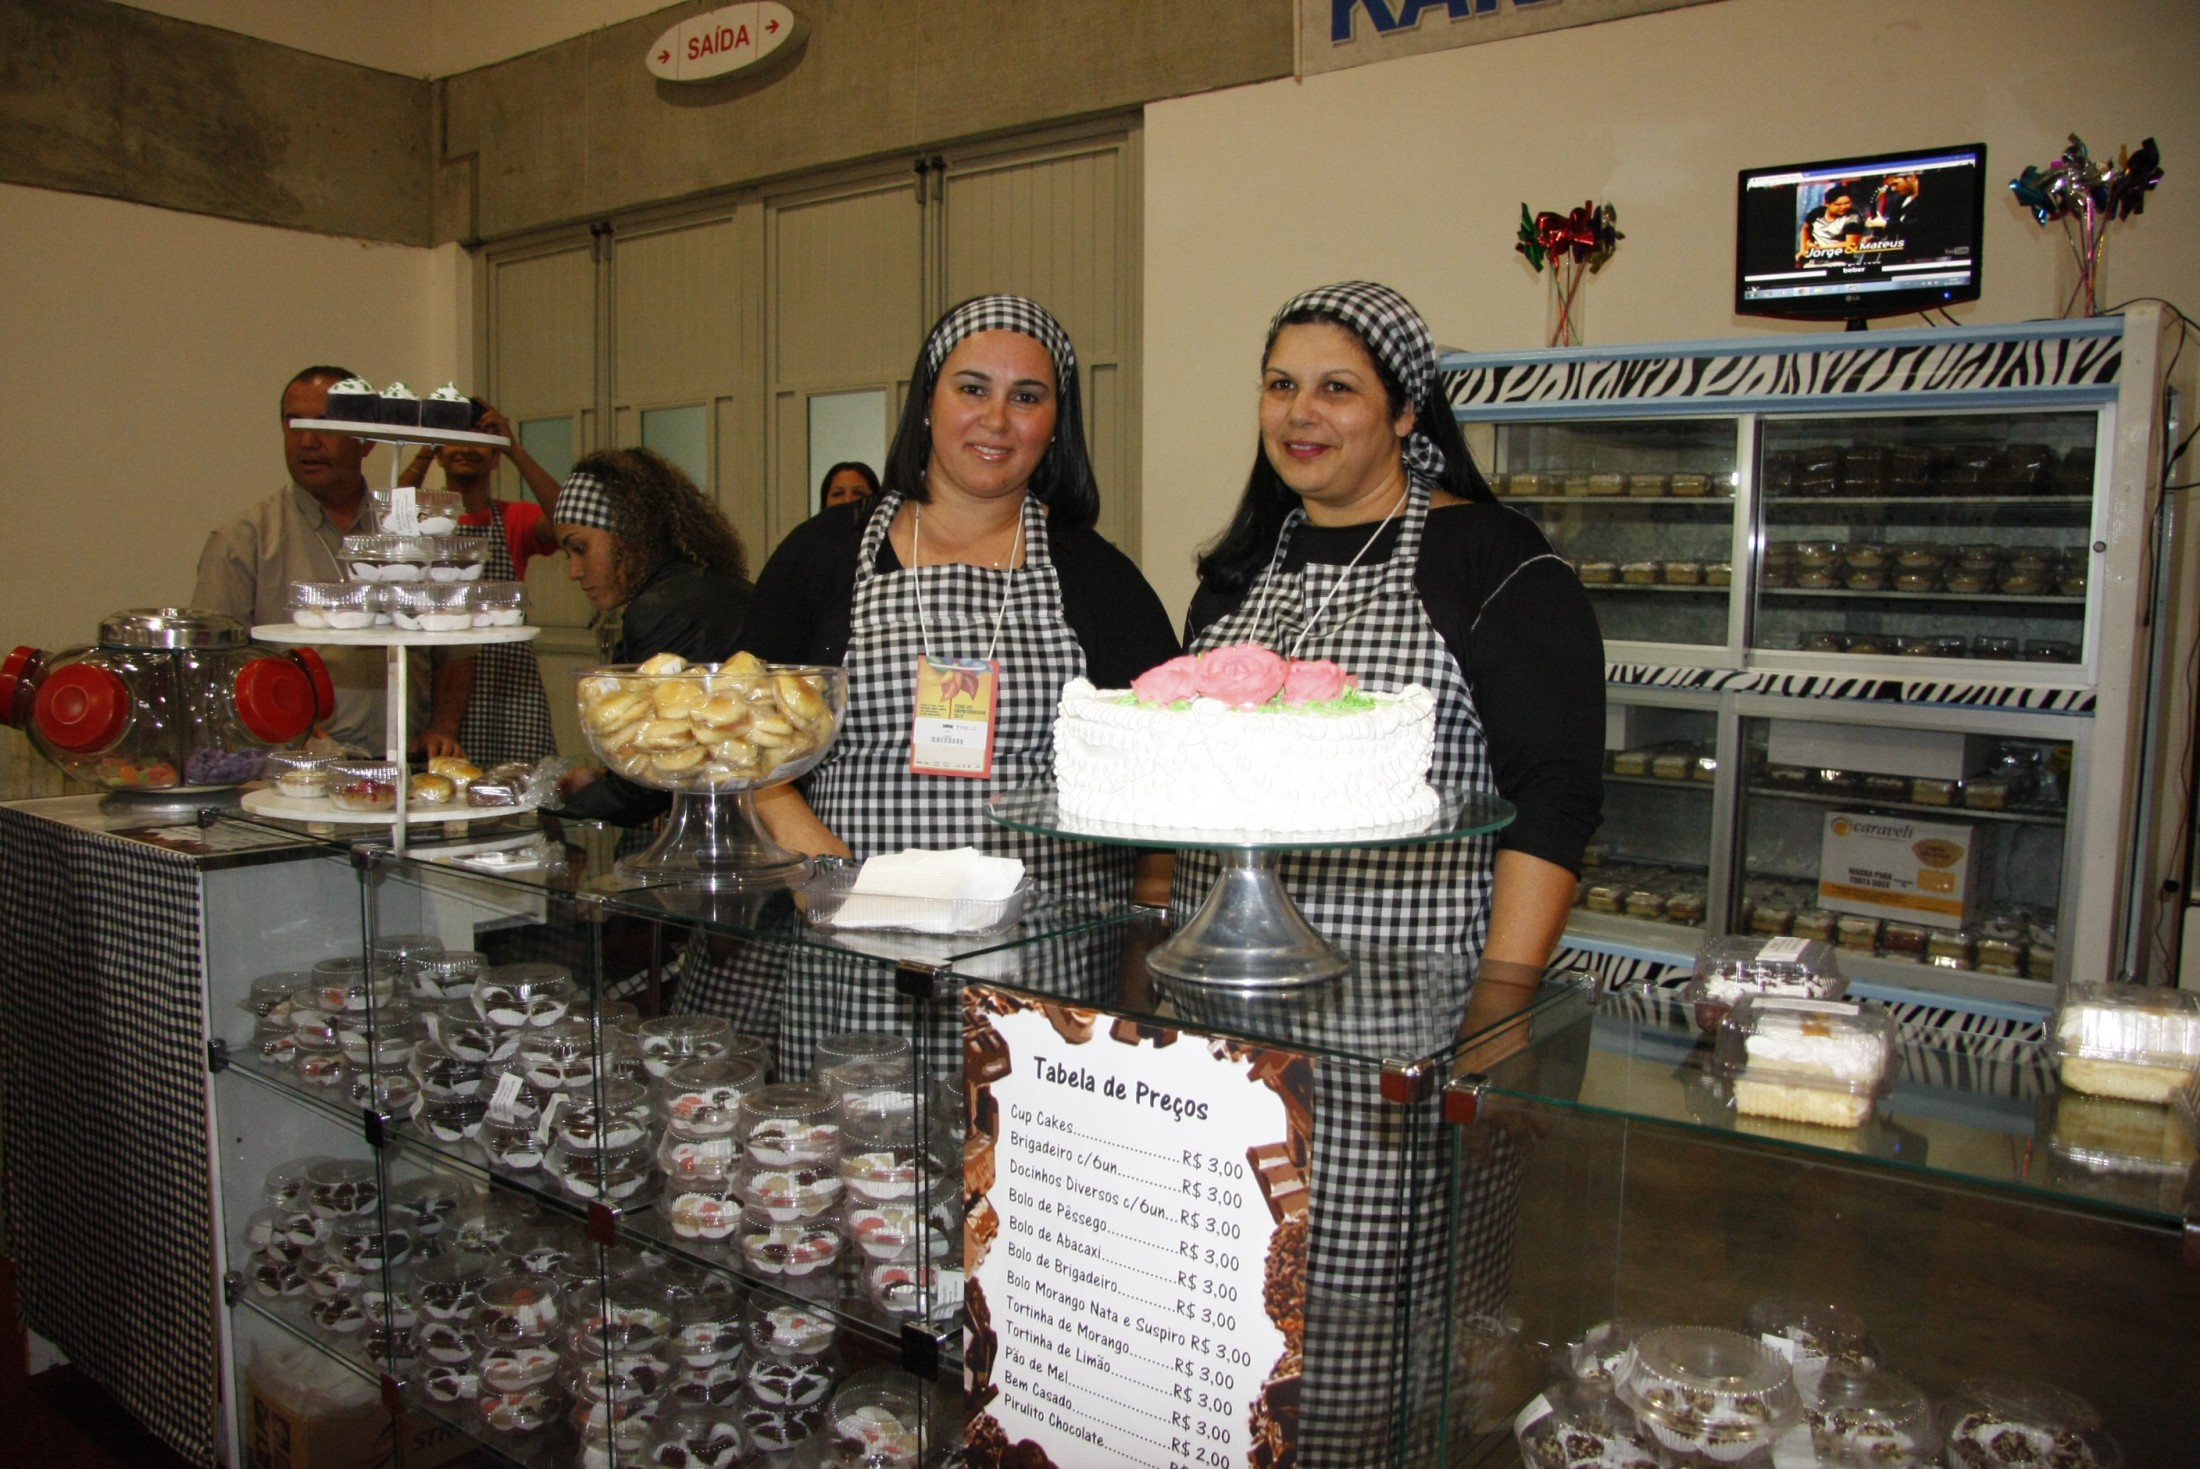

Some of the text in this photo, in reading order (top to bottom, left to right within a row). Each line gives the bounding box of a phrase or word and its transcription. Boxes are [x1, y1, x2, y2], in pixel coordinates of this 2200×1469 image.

[688, 25, 750, 60] SAÍDA
[1806, 239, 1905, 259] Jorge & Mateus
[1034, 1056, 1208, 1122] Tabela de Preços
[1010, 1130, 1073, 1161] Brigadeiro
[1182, 1179, 1202, 1199] R$
[1207, 1187, 1242, 1208] 3,00
[1011, 1104, 1032, 1126] Cup
[1183, 1150, 1202, 1170] R$
[1208, 1158, 1243, 1179] 3,00
[1009, 1187, 1033, 1207] Bolo
[1038, 1198, 1052, 1213] de
[1180, 1240, 1199, 1261] R$
[1204, 1249, 1239, 1271] 3,00
[1010, 1158, 1061, 1187] Docinhos
[1066, 1175, 1119, 1205] Diversos
[1180, 1209, 1200, 1230] R$
[1205, 1217, 1240, 1239] 3,00
[1008, 1242, 1032, 1262] Bolo
[1036, 1253, 1050, 1269] de
[1176, 1299, 1196, 1320] R$
[1201, 1308, 1236, 1331] 3,00
[1009, 1215, 1033, 1236] Bolo
[1038, 1227, 1052, 1242] de
[1178, 1270, 1197, 1291] R$
[1202, 1279, 1237, 1301] 3,00
[1006, 1295, 1053, 1326] Tortinha
[1058, 1317, 1072, 1332] de
[1175, 1357, 1194, 1378] R$
[1199, 1367, 1234, 1390] 3,00
[1007, 1270, 1251, 1367] Bolo Morango Nata e Suspiro R$ 3,00
[1005, 1346, 1025, 1365] Pão
[1029, 1358, 1043, 1373] de
[1172, 1411, 1191, 1432] R$
[1196, 1421, 1231, 1444] 3,00
[1005, 1393, 1044, 1421] Pirulito
[1006, 1320, 1052, 1351] Tortinha
[1057, 1343, 1071, 1357] de
[1173, 1383, 1193, 1404] R$
[1197, 1393, 1232, 1416] 3,00
[1005, 1370, 1028, 1392] Bem
[1171, 1437, 1191, 1458] R$
[1195, 1447, 1230, 1469] 2,00
